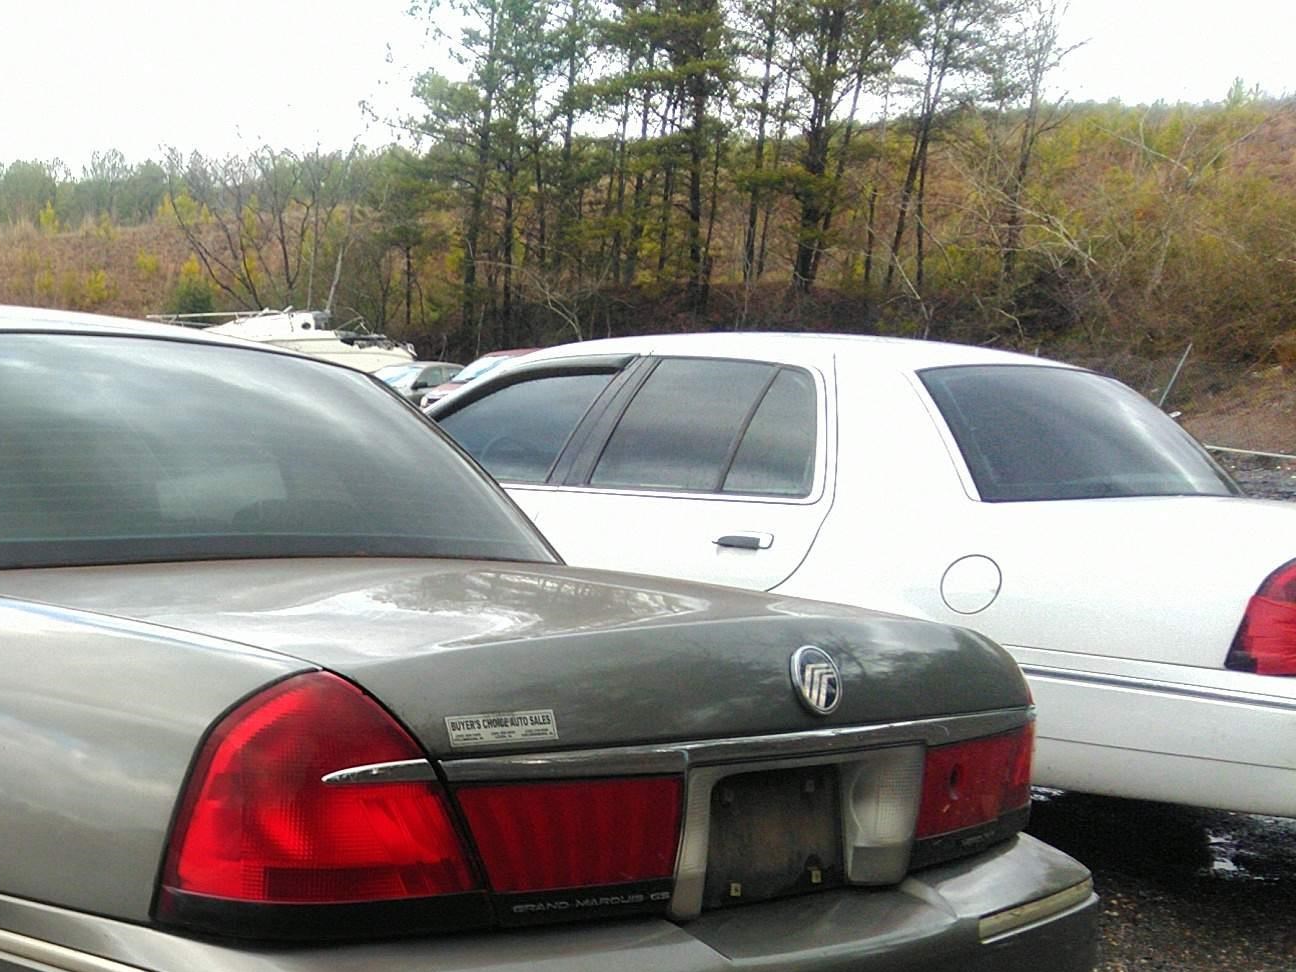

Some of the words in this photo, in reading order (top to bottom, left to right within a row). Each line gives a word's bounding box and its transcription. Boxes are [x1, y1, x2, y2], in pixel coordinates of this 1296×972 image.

[451, 720, 482, 731] BUYER'S
[483, 717, 510, 729] CHOICE
[510, 715, 529, 727] AUTO
[529, 714, 551, 725] SALES
[512, 901, 569, 913] GRAND
[576, 894, 644, 908] MARQUIS
